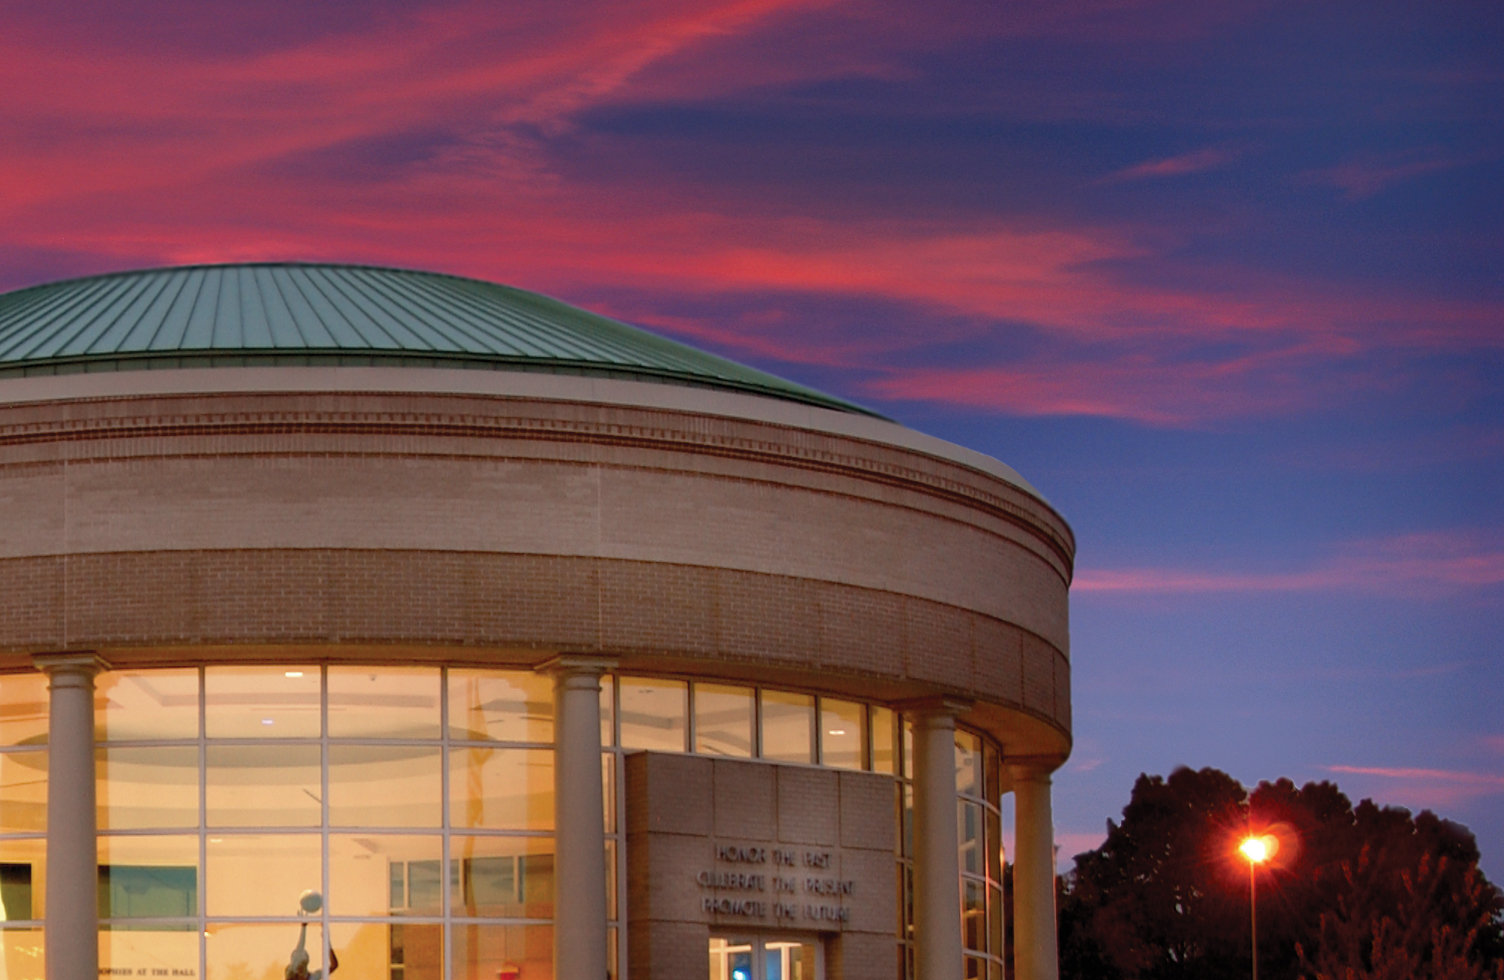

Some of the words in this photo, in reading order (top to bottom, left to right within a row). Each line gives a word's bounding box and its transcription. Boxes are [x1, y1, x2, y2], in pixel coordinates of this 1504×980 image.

[715, 845, 766, 863] HONOR
[772, 849, 795, 867] THE
[803, 852, 832, 869] PAST
[696, 871, 765, 892] CELEBRATE
[772, 876, 795, 894] THE
[804, 878, 854, 896] PRESENT
[701, 897, 766, 917] PROMOTE
[772, 902, 796, 920] THE
[804, 902, 850, 922] FUTURE
